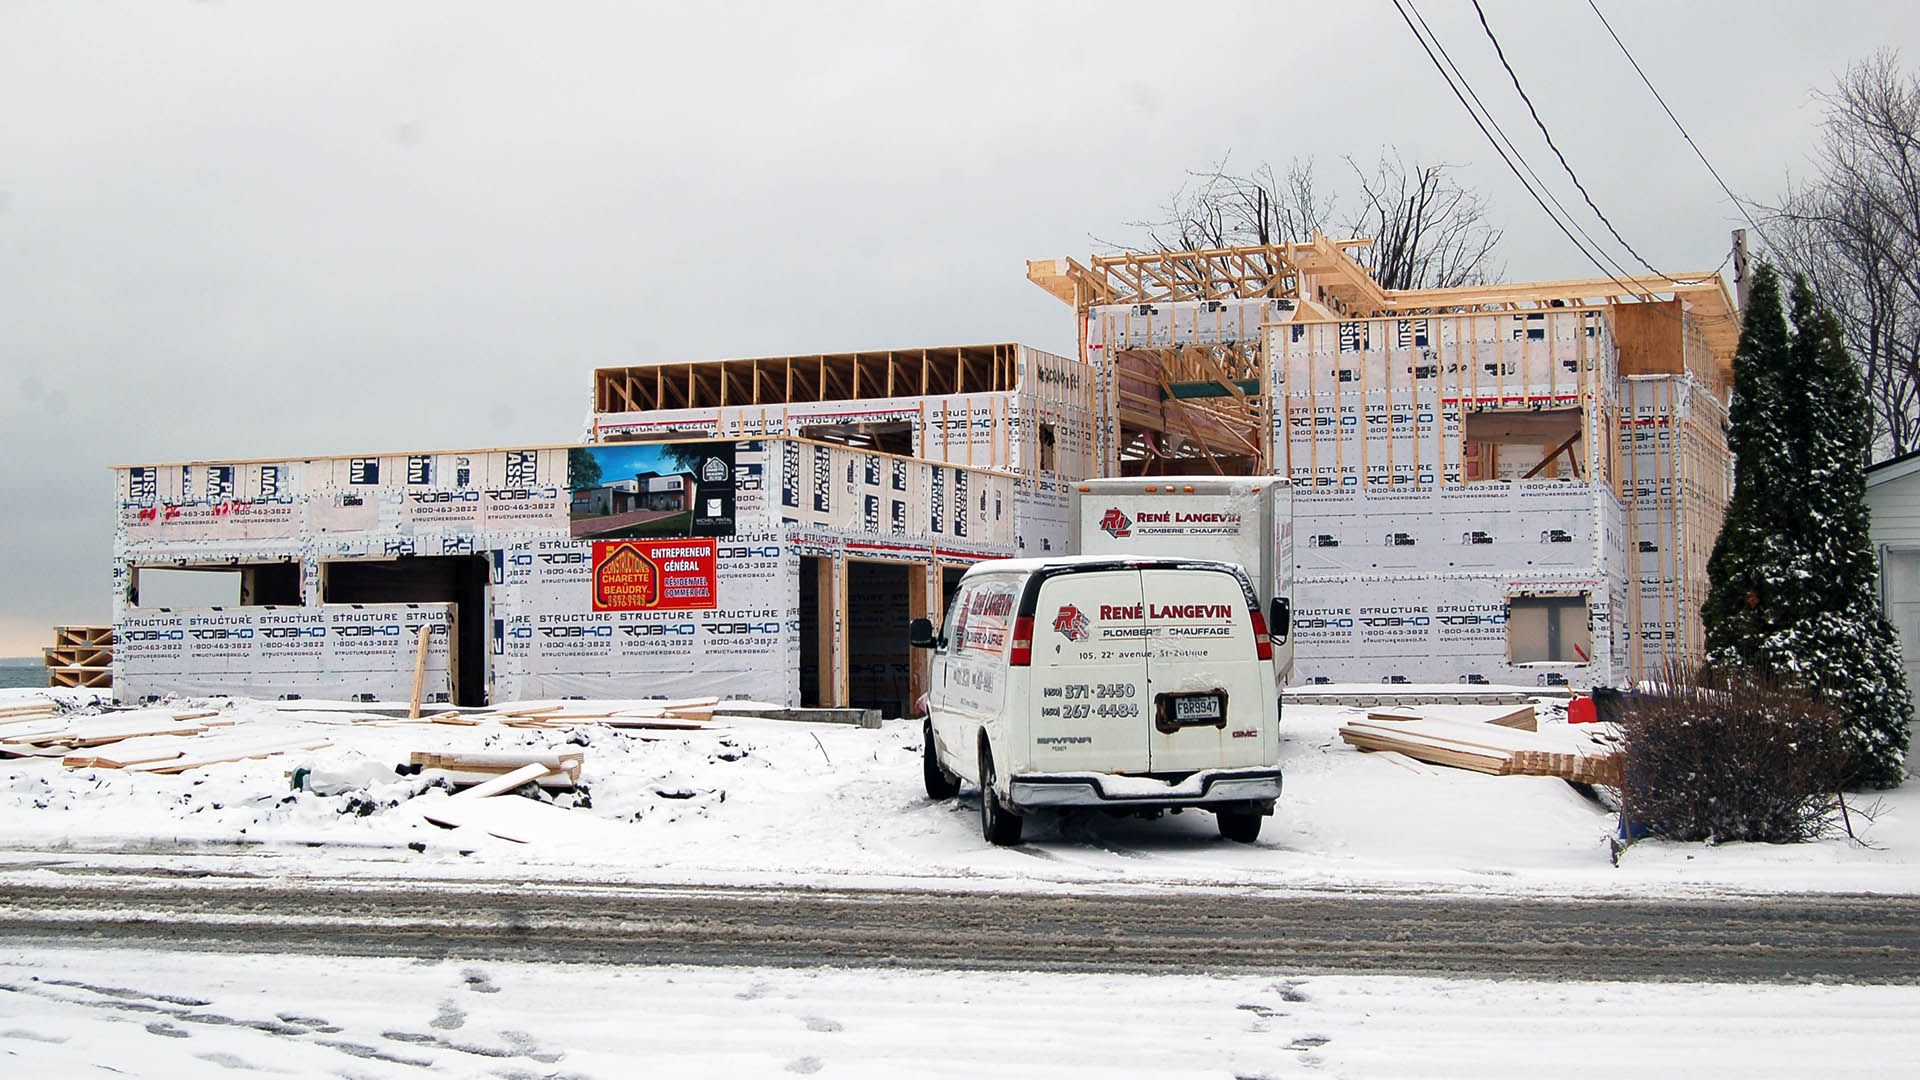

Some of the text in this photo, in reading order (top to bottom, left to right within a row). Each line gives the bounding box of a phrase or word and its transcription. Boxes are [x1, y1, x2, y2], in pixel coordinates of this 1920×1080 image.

[408, 491, 480, 503] ROBKO
[486, 503, 556, 511] 1-800-463-3822
[1137, 511, 1241, 523] RENÉ LANGEVIN
[651, 546, 711, 559] ENTREPRENEUR
[664, 559, 699, 572] GÉNÉRAL
[602, 574, 649, 584] CHARETTE
[664, 575, 708, 587] RÉSIDENTIEL
[604, 585, 648, 594] BEAUDRY
[664, 587, 710, 598] COMMERCIAL
[1100, 602, 1232, 620] RENÉ LANGEVIN
[1360, 606, 1428, 615] STRUCTURE
[1436, 604, 1506, 613] STRUCTURE
[260, 615, 325, 624] STRUCTURE
[332, 613, 398, 622] STRUCTURE
[539, 613, 611, 623] STRUCTURE
[620, 611, 693, 621] STRUCTURE
[703, 610, 778, 619] STRUCTURE
[190, 616, 252, 625] STRUCTURE
[1359, 616, 1430, 627] ROBKO
[1435, 614, 1507, 626] ROBKO
[259, 627, 326, 638] ROBKO
[331, 625, 400, 637] ROBKO
[538, 625, 612, 638] ROBKO
[618, 623, 695, 636] ROBKO
[701, 622, 780, 635] ROBKO
[1169, 628, 1230, 636] CHAUFFAGE
[1360, 628, 1429, 636] 1-800-463-3822
[189, 629, 254, 640] ROBKO
[332, 639, 399, 647] 1-800-463-3822
[540, 640, 611, 649] 1-800-463-3822
[620, 639, 693, 647] 1-800-463-3822
[1177, 701, 1218, 715] FBR9947
[1232, 730, 1258, 738] GMC
[1037, 736, 1092, 744] SAVANA
